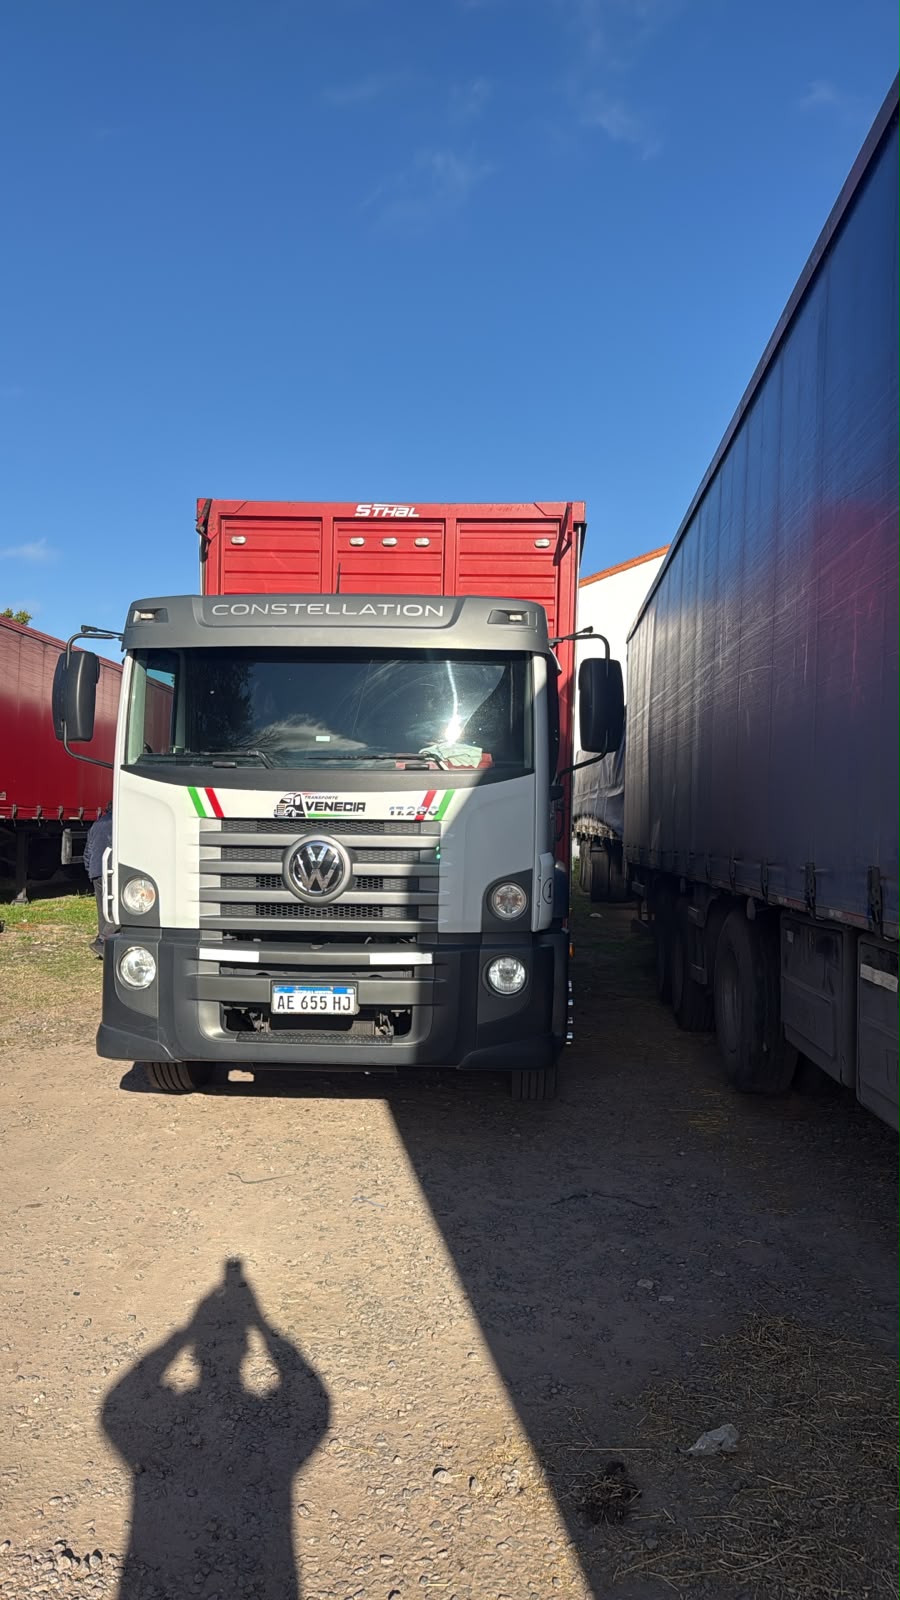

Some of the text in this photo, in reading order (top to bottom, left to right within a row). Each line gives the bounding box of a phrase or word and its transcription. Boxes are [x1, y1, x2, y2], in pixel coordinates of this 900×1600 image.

[211, 603, 444, 617] CONSTELLATION
[305, 801, 366, 812] VENECIA
[277, 995, 351, 1011] AE 655 HJ
